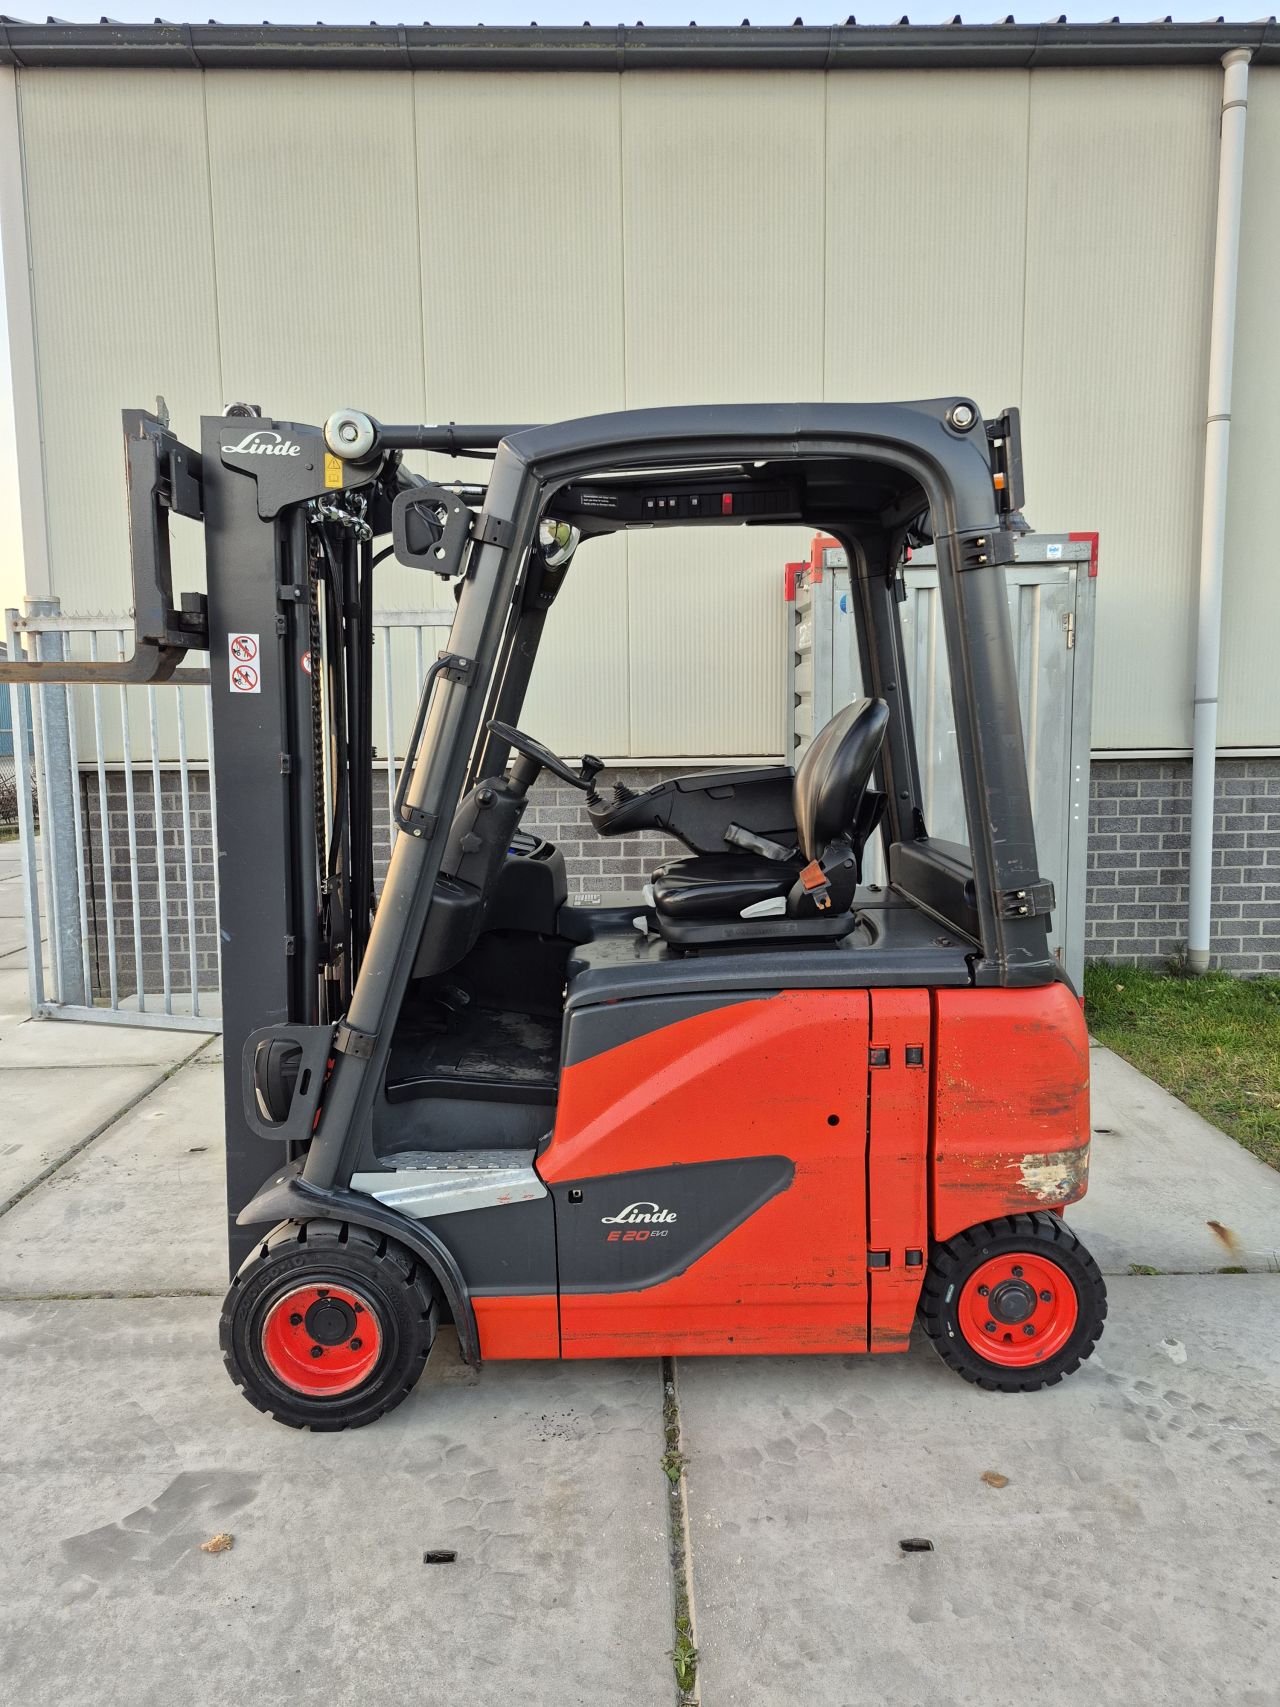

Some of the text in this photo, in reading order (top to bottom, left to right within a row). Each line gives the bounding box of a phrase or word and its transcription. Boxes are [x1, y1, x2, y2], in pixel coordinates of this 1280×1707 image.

[221, 431, 301, 457] Linde
[601, 1201, 677, 1224] Linde
[607, 1229, 669, 1241] E 20 EVO
